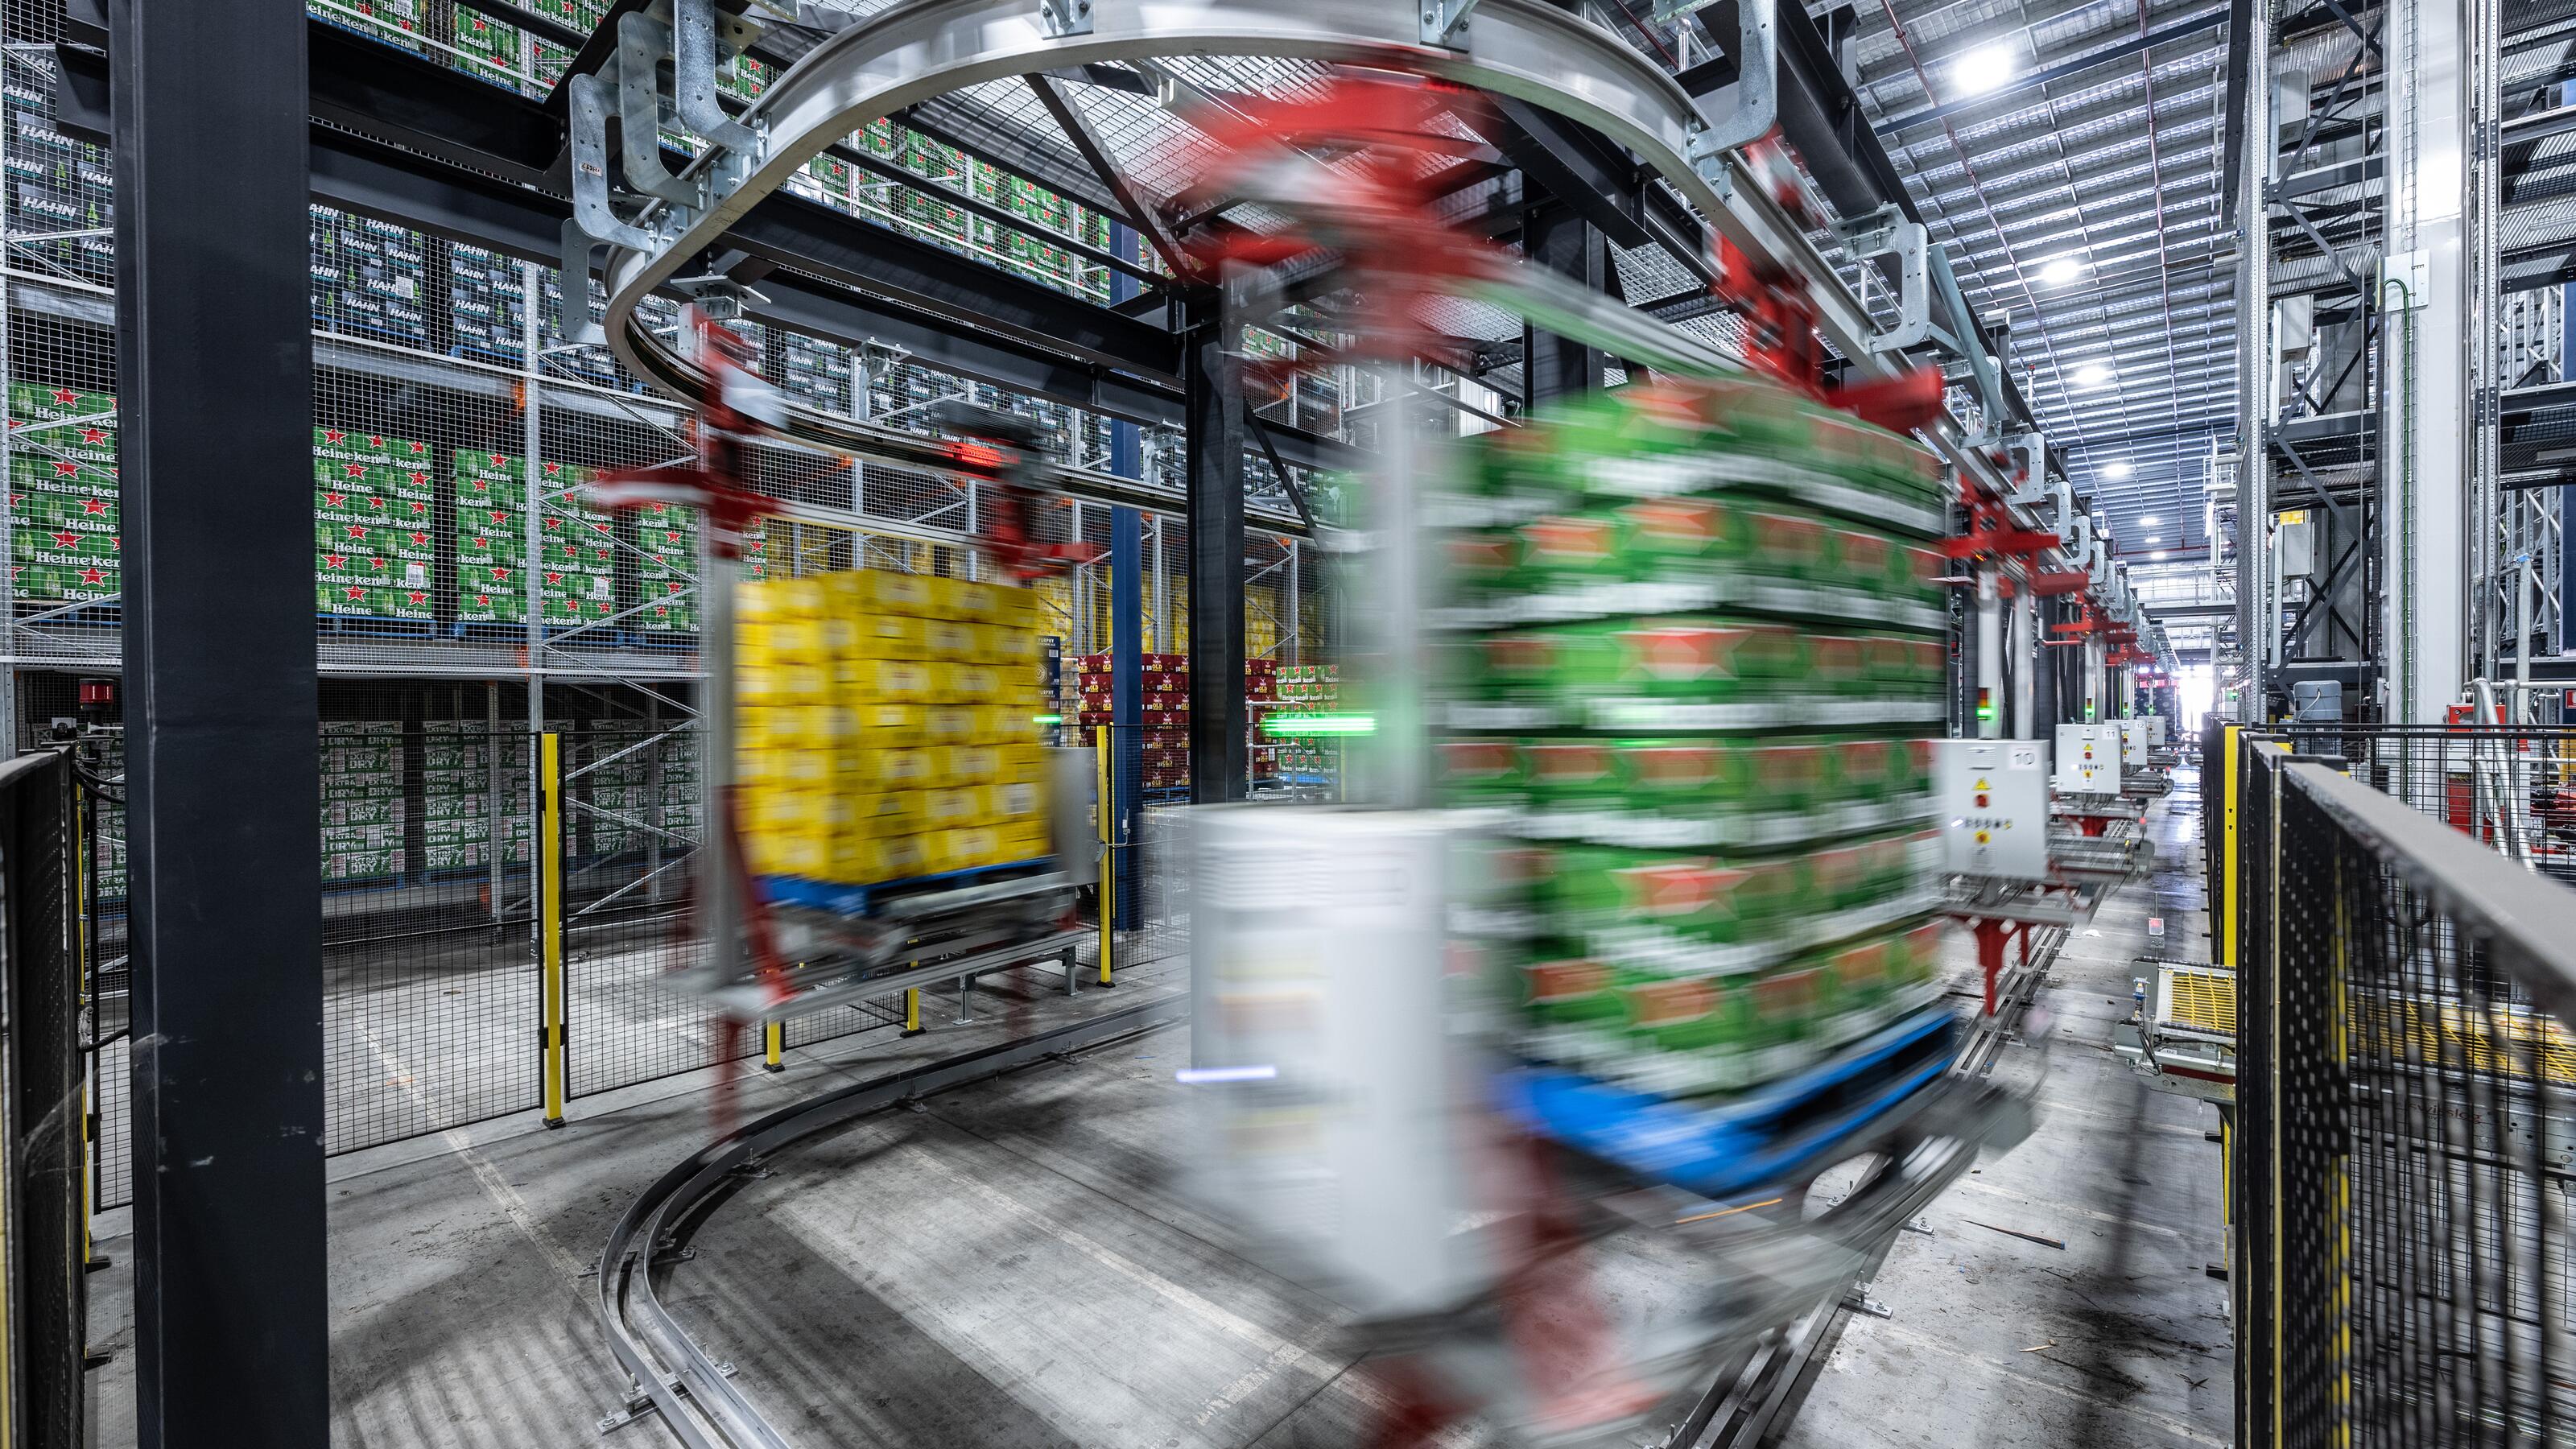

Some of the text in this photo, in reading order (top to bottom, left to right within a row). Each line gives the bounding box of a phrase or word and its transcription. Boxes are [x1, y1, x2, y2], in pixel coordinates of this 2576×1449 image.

[3, 85, 44, 102] AHN
[5, 156, 44, 174] AHN
[81, 171, 113, 185] HAH
[309, 203, 339, 217] AHN
[83, 241, 114, 254] HAH
[310, 265, 339, 279] AHN
[367, 279, 398, 292] HAH
[332, 480, 373, 493] Heine
[539, 477, 565, 489] eine
[65, 518, 116, 532] Heine
[334, 543, 374, 555] Heine
[332, 604, 372, 615] Heine
[396, 608, 433, 619] Heine
